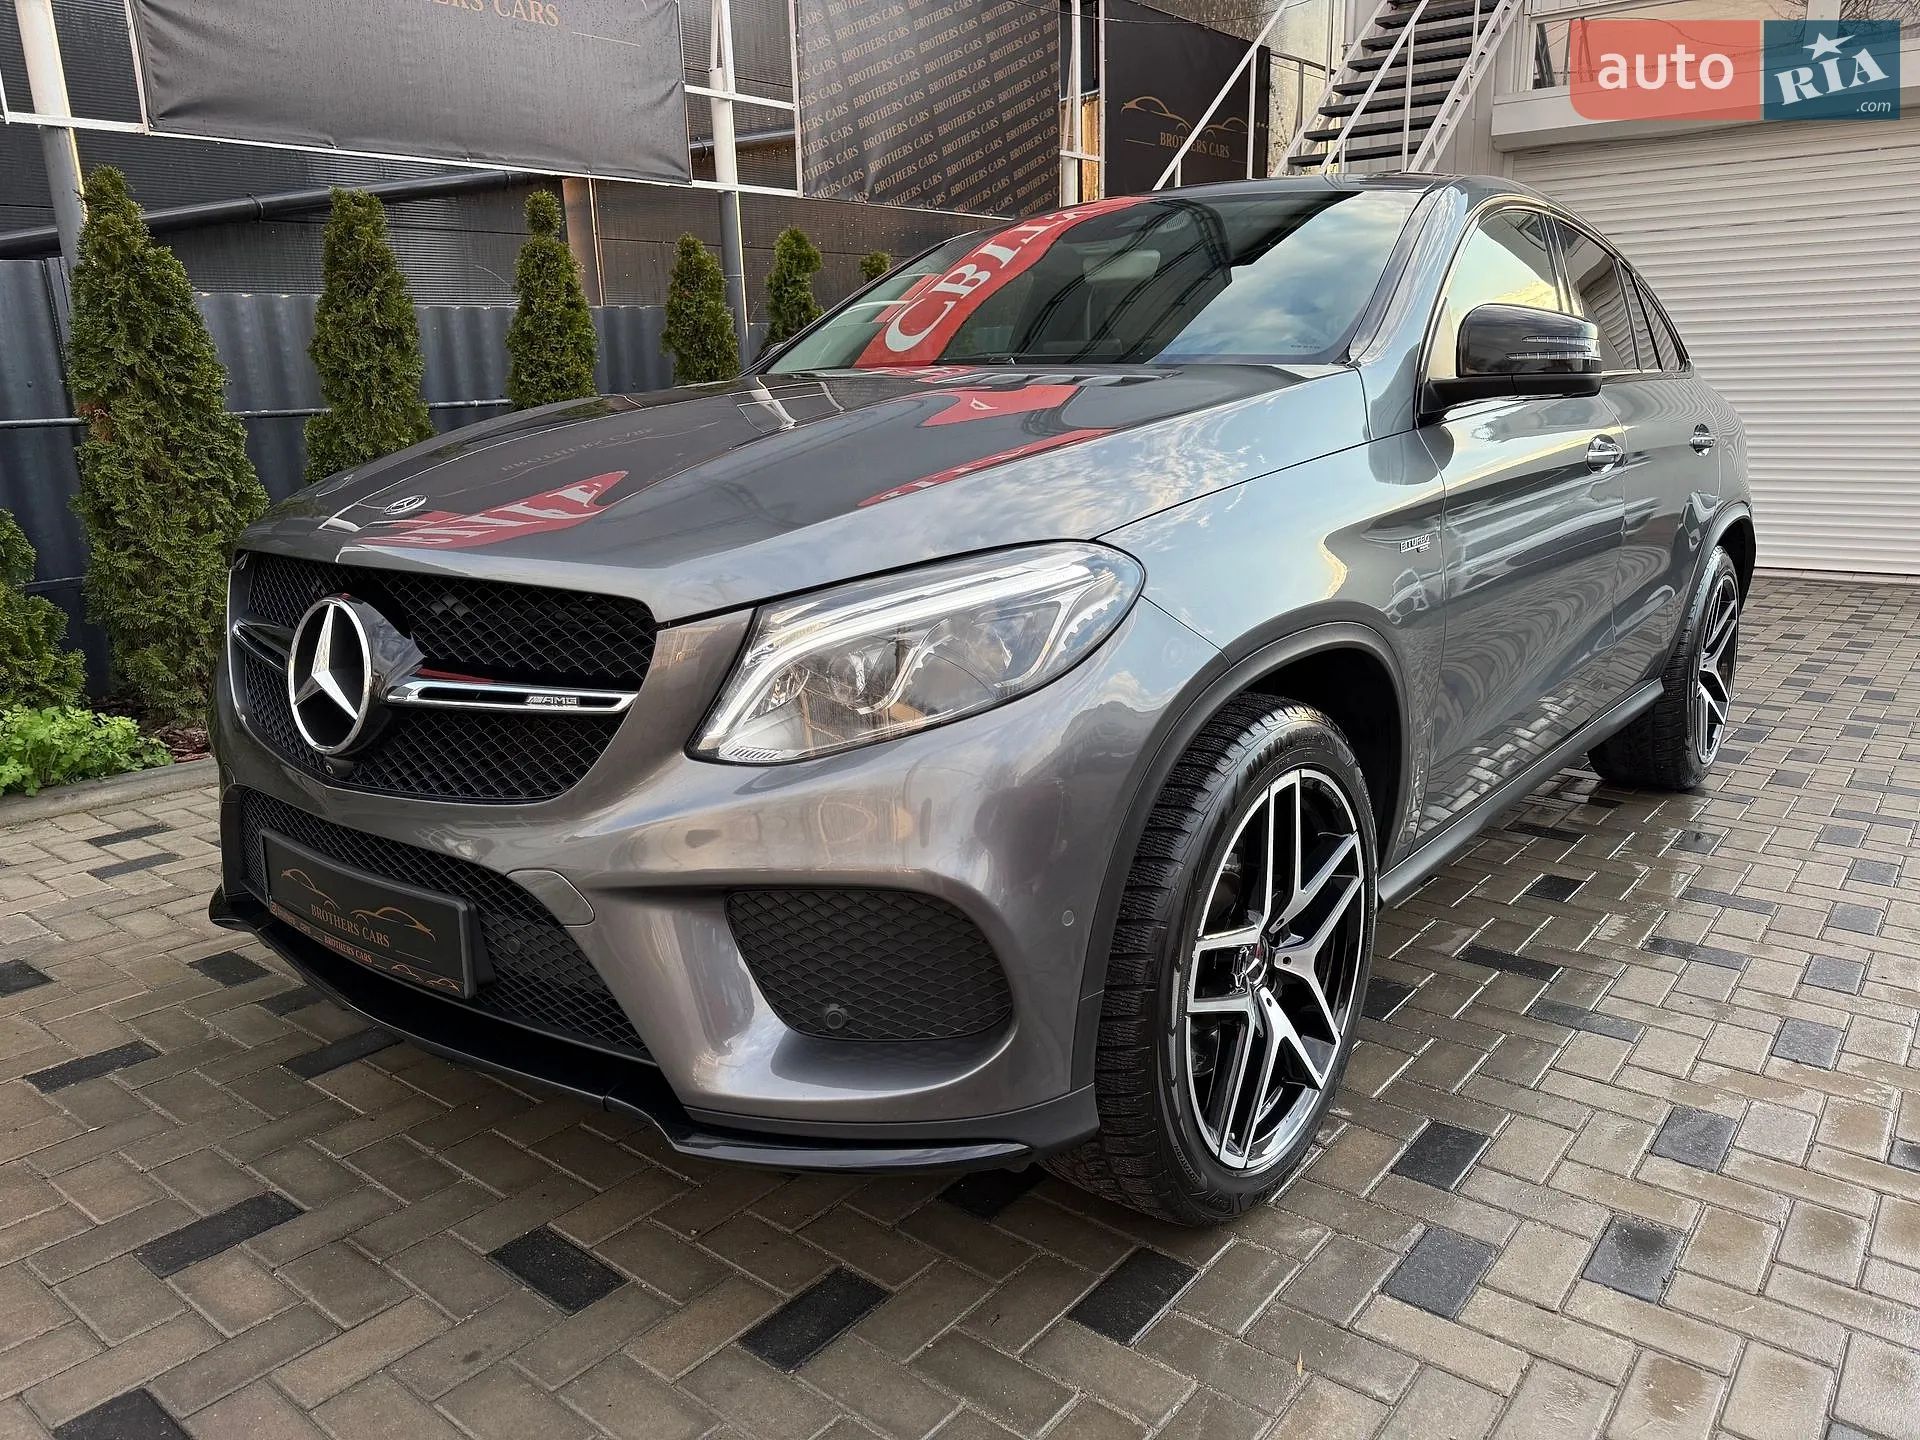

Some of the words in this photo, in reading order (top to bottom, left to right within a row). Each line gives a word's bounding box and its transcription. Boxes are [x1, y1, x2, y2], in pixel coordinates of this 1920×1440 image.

[494, 0, 559, 26] CARS
[798, 10, 823, 28] CARS
[805, 33, 830, 52] CARS
[835, 13, 880, 39] BROTHERS
[882, 3, 904, 20] CARS
[812, 57, 836, 76] CARS
[842, 36, 887, 63] BROTHERS
[888, 25, 910, 42] CARS
[914, 5, 953, 31] BROTHERS
[819, 81, 842, 99] CARS
[848, 58, 892, 85] BROTHERS
[894, 48, 915, 64] CARS
[919, 27, 958, 52] BROTHERS
[959, 18, 977, 33] CARS
[825, 103, 848, 121] CARS
[853, 79, 898, 108] BROTHERS
[900, 69, 920, 86] CARS
[925, 48, 963, 73] BROTHERS
[964, 38, 982, 54] CARS
[986, 20, 1019, 43] BROTHERS
[1021, 12, 1037, 26] CARS
[830, 124, 853, 143] CARS
[858, 100, 903, 129] BROTHERS
[904, 89, 925, 106] CARS
[928, 68, 967, 94] BROTHERS
[968, 58, 986, 74] CARS
[990, 39, 1023, 63] BROTHERS
[1024, 30, 1040, 45] CARS
[836, 146, 858, 165] CARS
[864, 120, 908, 150] BROTHERS
[909, 109, 929, 126] CARS
[933, 88, 971, 114] BROTHERS
[973, 78, 990, 94] CARS
[994, 58, 1027, 82] BROTHERS
[1028, 49, 1044, 63] CARS
[842, 169, 864, 187] CARS
[870, 143, 912, 172] BROTHERS
[914, 131, 934, 148] CARS
[938, 109, 975, 136] BROTHERS
[977, 98, 994, 114] CARS
[999, 78, 1031, 102] BROTHERS
[1032, 69, 1048, 84] CARS
[875, 163, 917, 194] BROTHERS
[918, 151, 938, 169] CARS
[942, 128, 979, 156] BROTHERS
[981, 118, 998, 134] CARS
[1002, 97, 1035, 122] BROTHERS
[1036, 87, 1051, 102] CARS
[922, 173, 942, 190] CARS
[947, 148, 983, 176] BROTHERS
[985, 137, 1002, 154] CARS
[1006, 116, 1038, 141] BROTHERS
[1040, 107, 1054, 121] CARS
[927, 192, 946, 210] CARS
[951, 167, 987, 196] BROTHERS
[988, 156, 1006, 173] CARS
[1010, 135, 1042, 160] BROTHERS
[1043, 125, 1057, 139] CARS
[992, 176, 1009, 193] CARS
[1014, 153, 1045, 179] BROTHERS
[1160, 132, 1206, 154] BROTERS
[1209, 142, 1230, 158] CARS
[996, 195, 1013, 211] CARS
[1017, 172, 1049, 198] BROTHERS
[542, 696, 577, 705] AMG
[311, 904, 360, 936] BROTHERS
[362, 927, 390, 947] CARS
